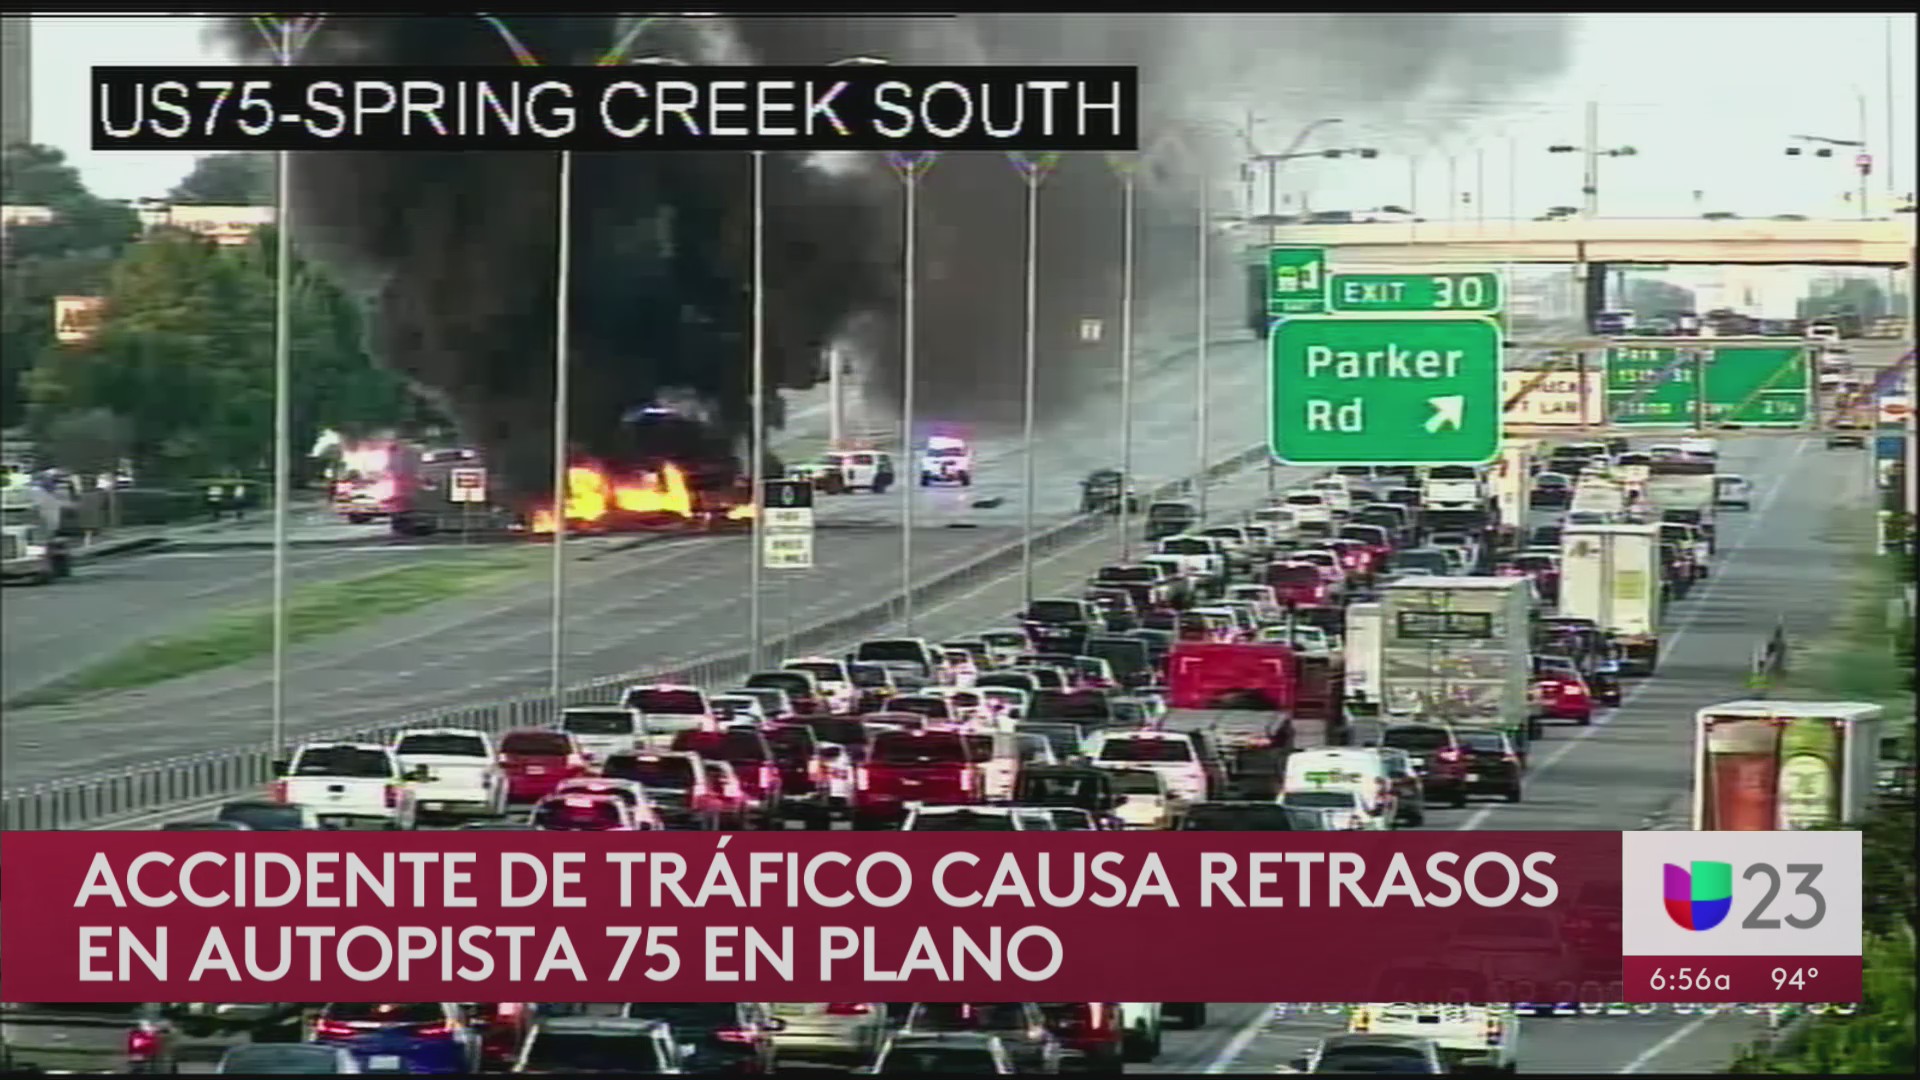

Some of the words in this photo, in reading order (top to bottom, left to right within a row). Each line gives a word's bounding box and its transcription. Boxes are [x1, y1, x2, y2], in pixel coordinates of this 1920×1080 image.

[1344, 281, 1406, 303] EXIT
[1432, 276, 1483, 308] 30
[1307, 345, 1463, 378] Parker
[1307, 400, 1362, 432] Rd
